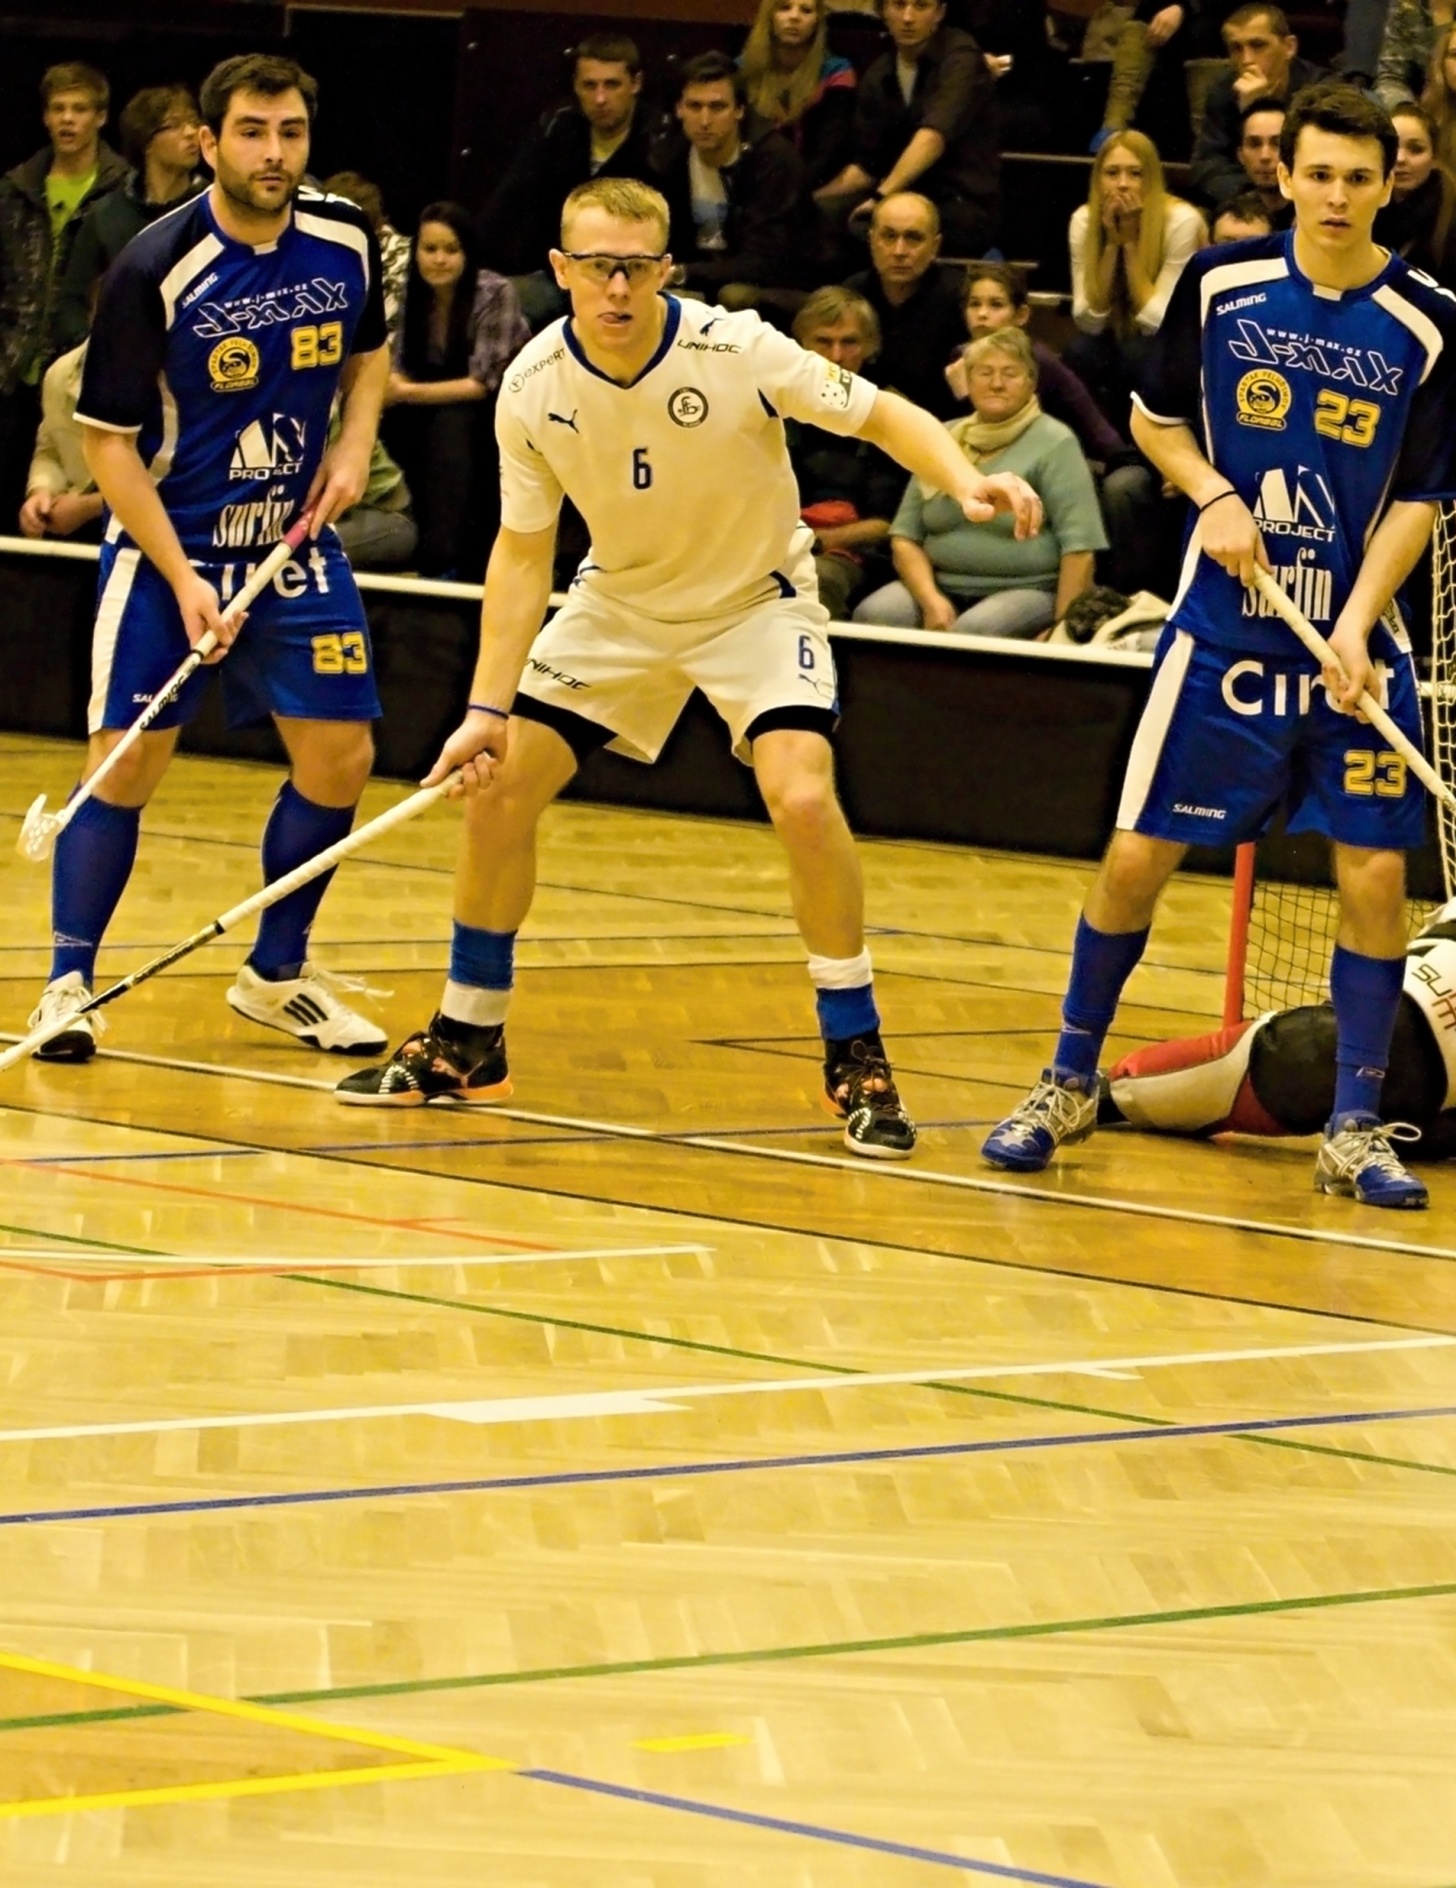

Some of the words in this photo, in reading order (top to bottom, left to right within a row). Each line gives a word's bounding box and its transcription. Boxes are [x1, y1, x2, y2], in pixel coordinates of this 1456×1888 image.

[1216, 292, 1267, 316] SALMING
[291, 320, 344, 370] 83
[677, 339, 743, 355] UNIHOC
[1266, 328, 1362, 357] www.j-max.cz
[1314, 388, 1381, 448] 23
[229, 462, 302, 481] PROECT
[632, 446, 652, 490] 6
[1253, 519, 1337, 543] PROJECT
[311, 631, 368, 675] 83
[798, 635, 815, 670] 6
[1343, 749, 1409, 798] 23
[1172, 803, 1227, 820] SALMING
